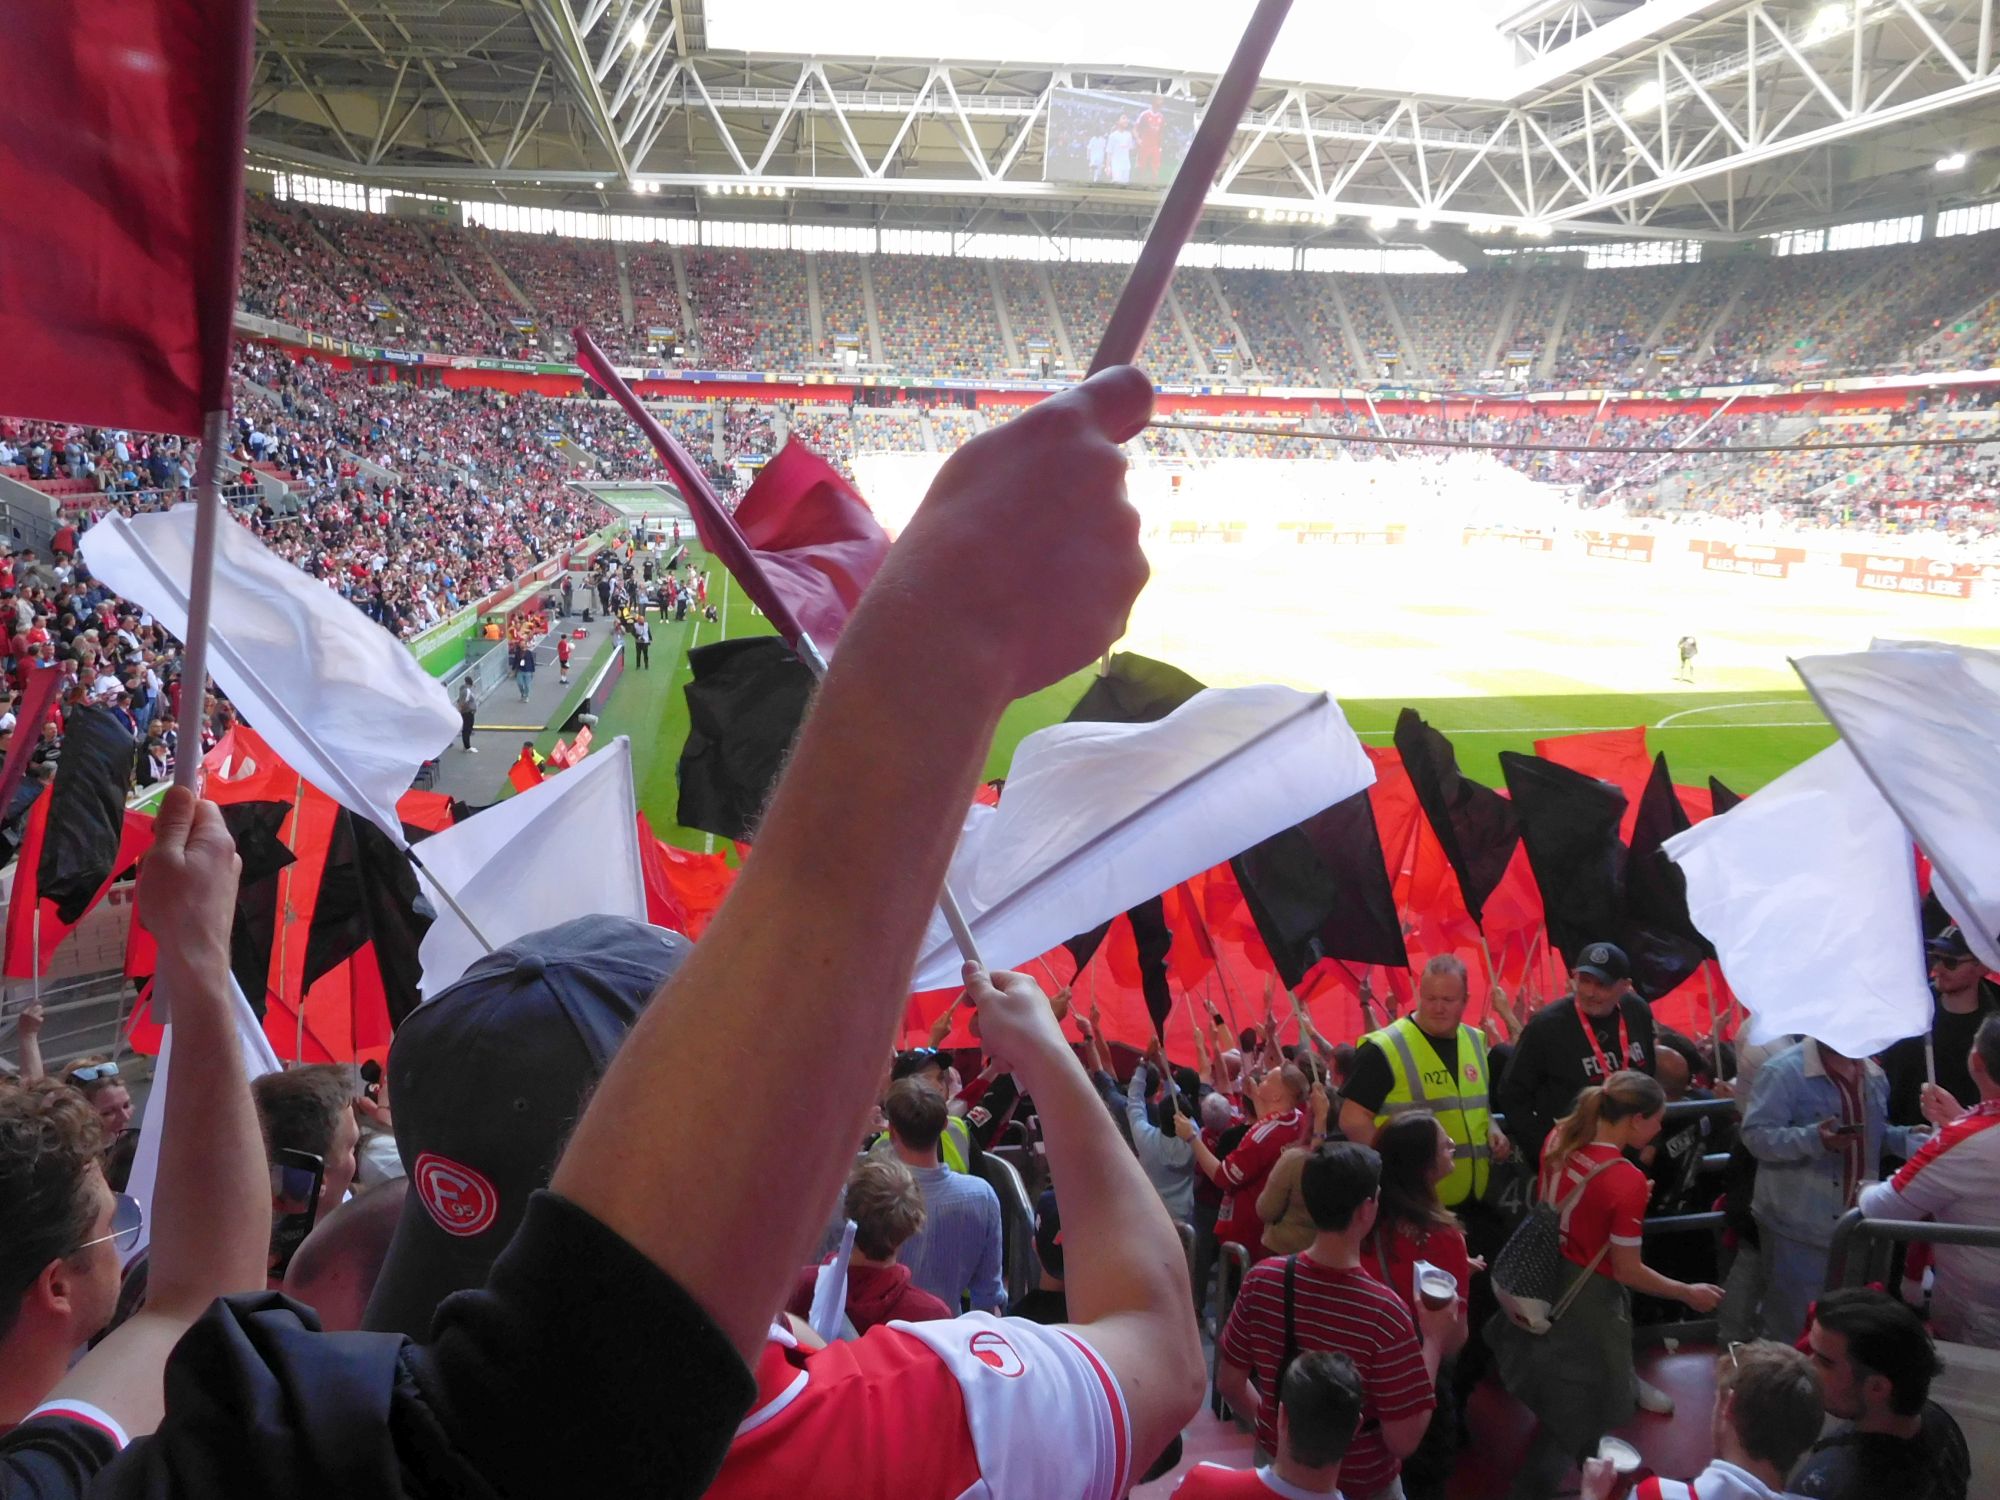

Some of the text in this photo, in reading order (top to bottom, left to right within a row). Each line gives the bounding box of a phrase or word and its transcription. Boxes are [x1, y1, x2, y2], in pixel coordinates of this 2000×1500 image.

[1707, 558, 1782, 577] ALLES AUS LIEBE
[1862, 573, 1962, 597] ALLES AUS LIEBE
